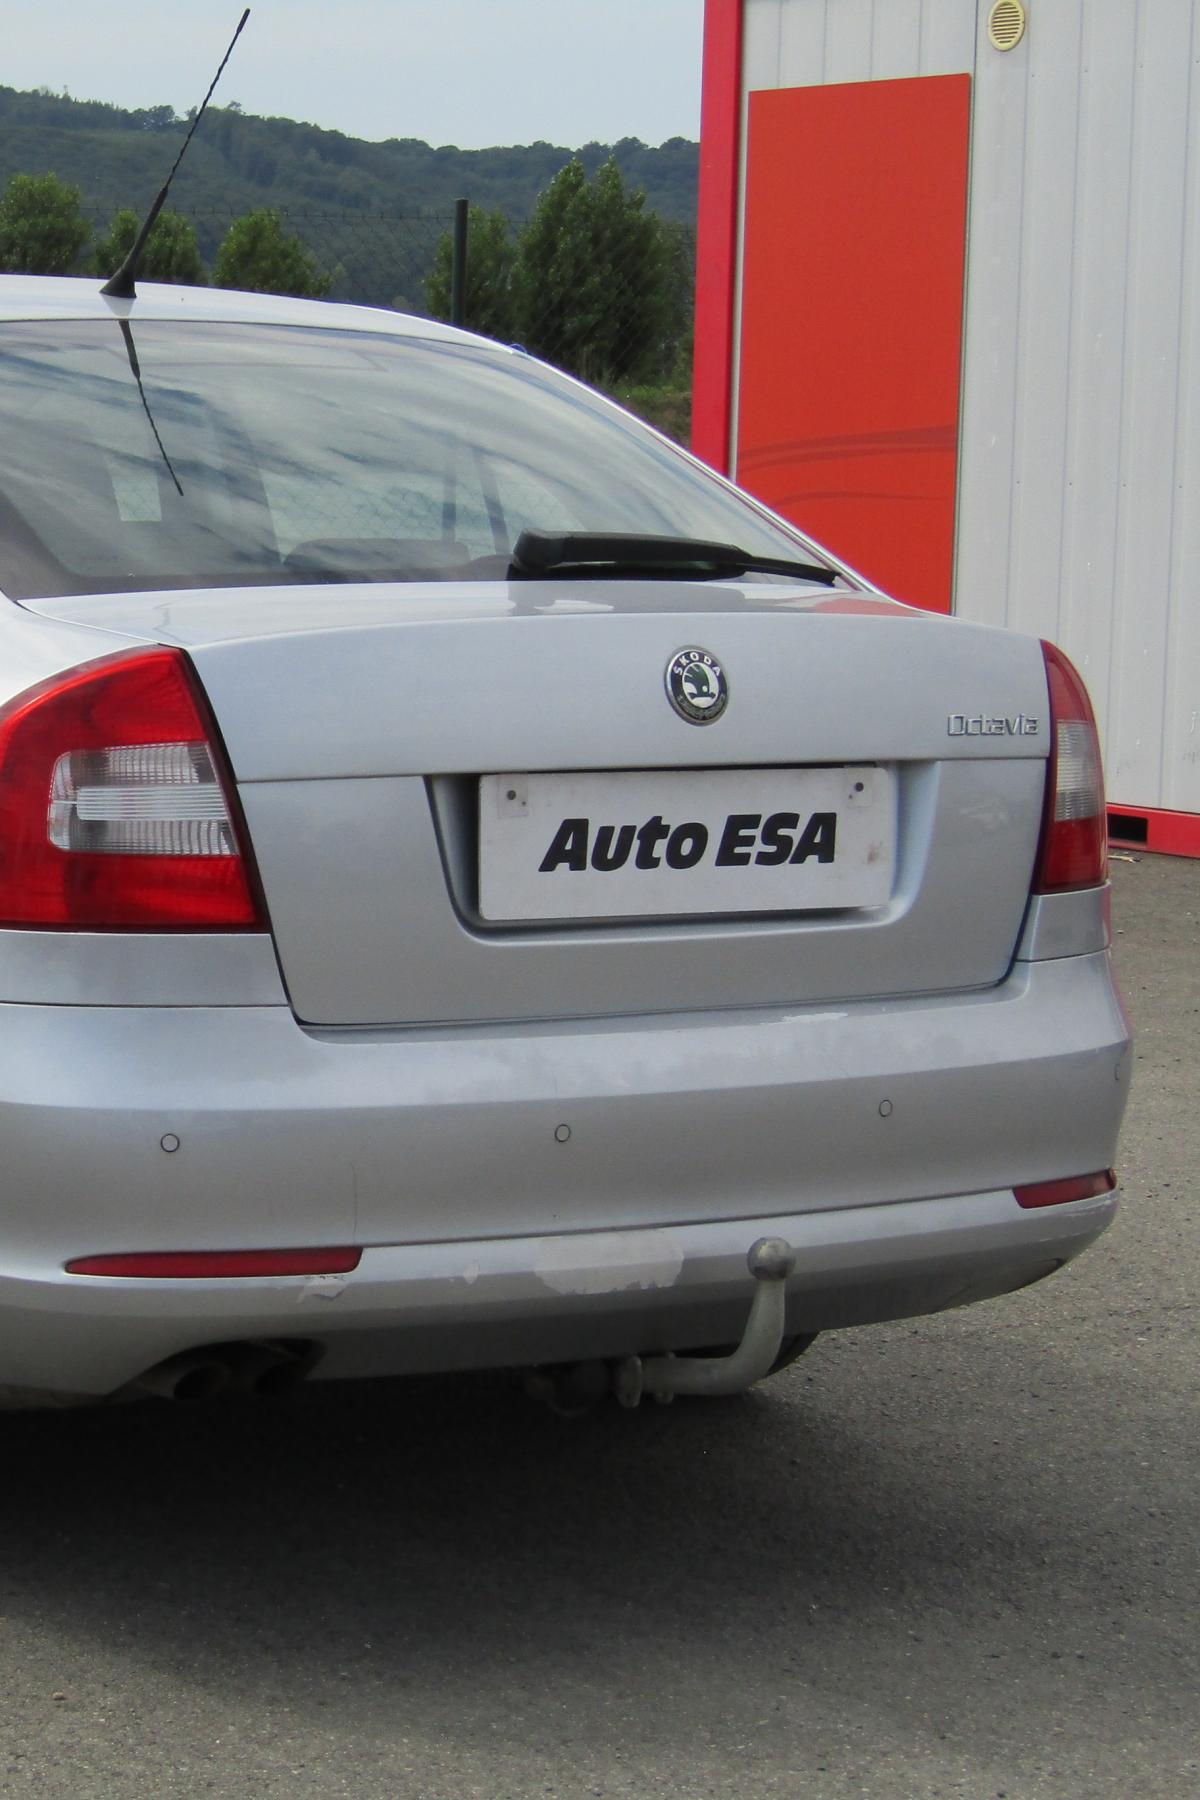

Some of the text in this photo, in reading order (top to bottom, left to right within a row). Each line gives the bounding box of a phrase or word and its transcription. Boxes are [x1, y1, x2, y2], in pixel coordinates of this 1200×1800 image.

[948, 713, 1039, 736] Octavia
[538, 812, 838, 872] Auto ESA
